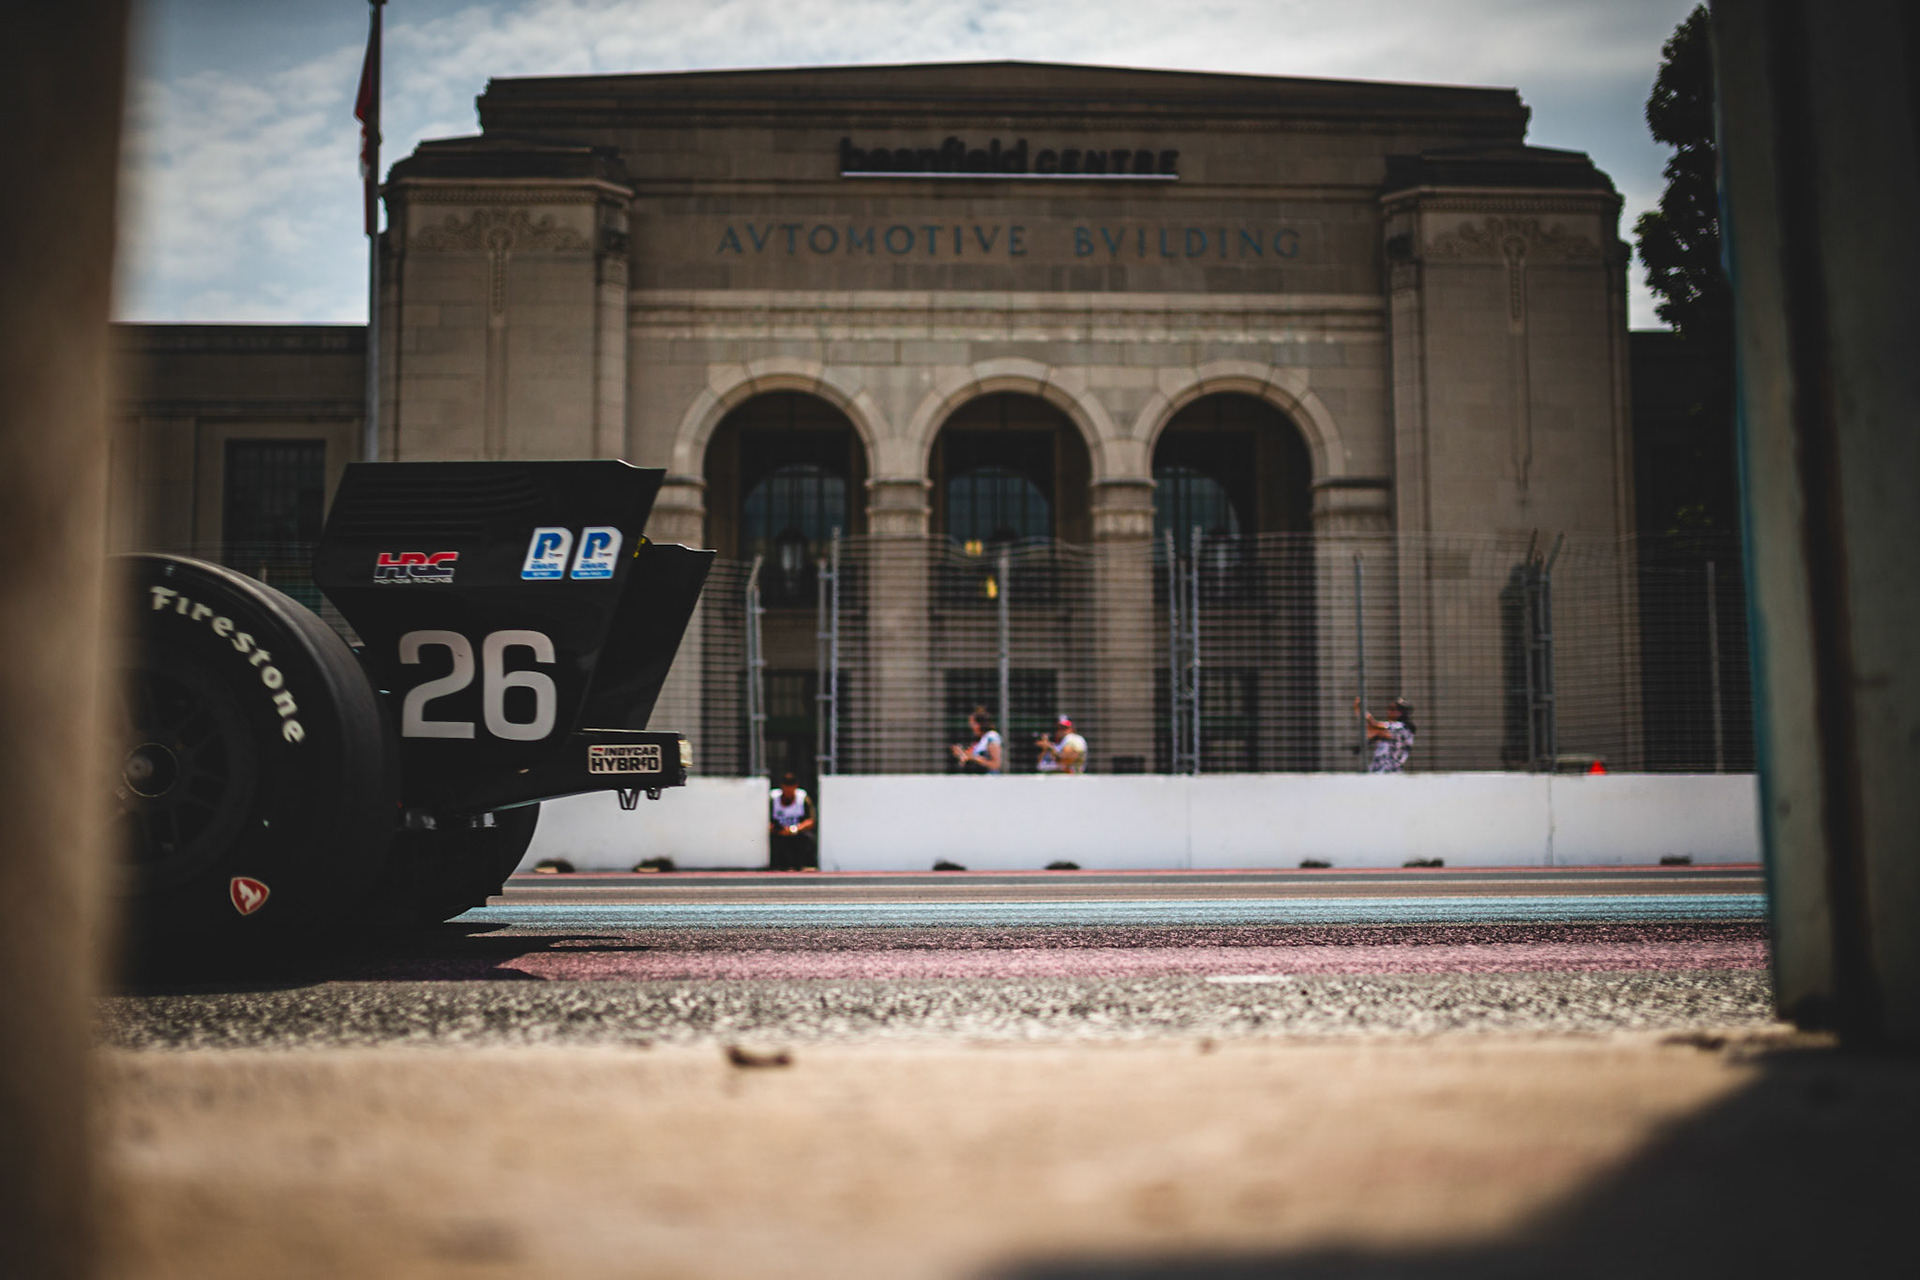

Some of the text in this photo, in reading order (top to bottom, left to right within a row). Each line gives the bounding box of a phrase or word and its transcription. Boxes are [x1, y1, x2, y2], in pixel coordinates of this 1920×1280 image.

[1036, 149, 1180, 174] CENTRE
[373, 551, 459, 578] HRC
[150, 585, 305, 743] Firestone
[400, 629, 557, 741] 26
[605, 746, 658, 756] INDYCAR
